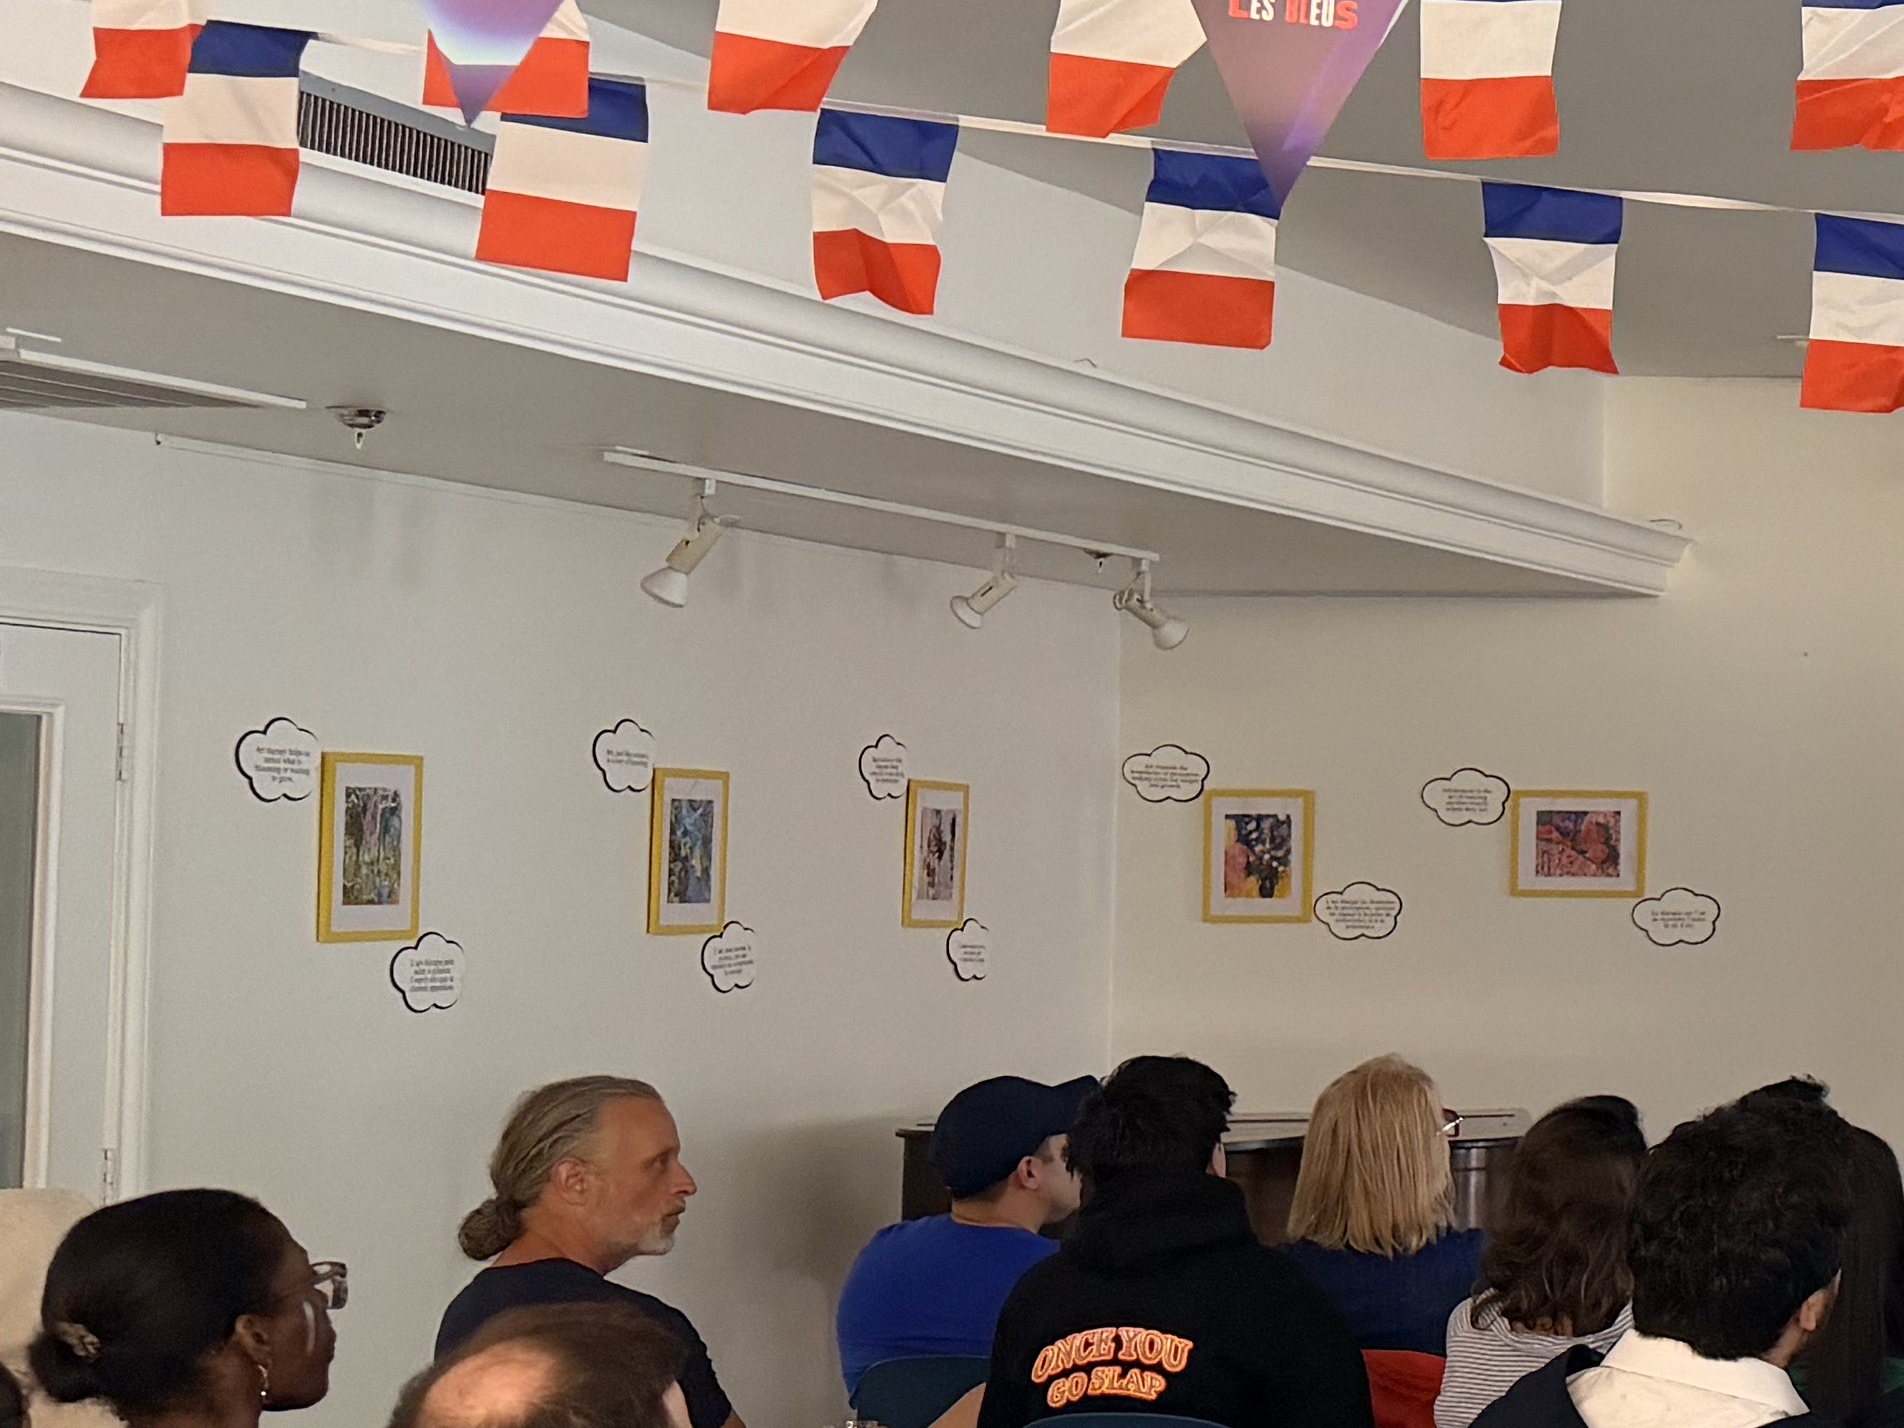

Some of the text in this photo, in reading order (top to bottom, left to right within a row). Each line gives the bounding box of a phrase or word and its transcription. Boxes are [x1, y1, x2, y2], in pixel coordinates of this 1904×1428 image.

[1031, 1327, 1194, 1384] ONCE YOU
[1047, 1366, 1167, 1408] GO SLAP
